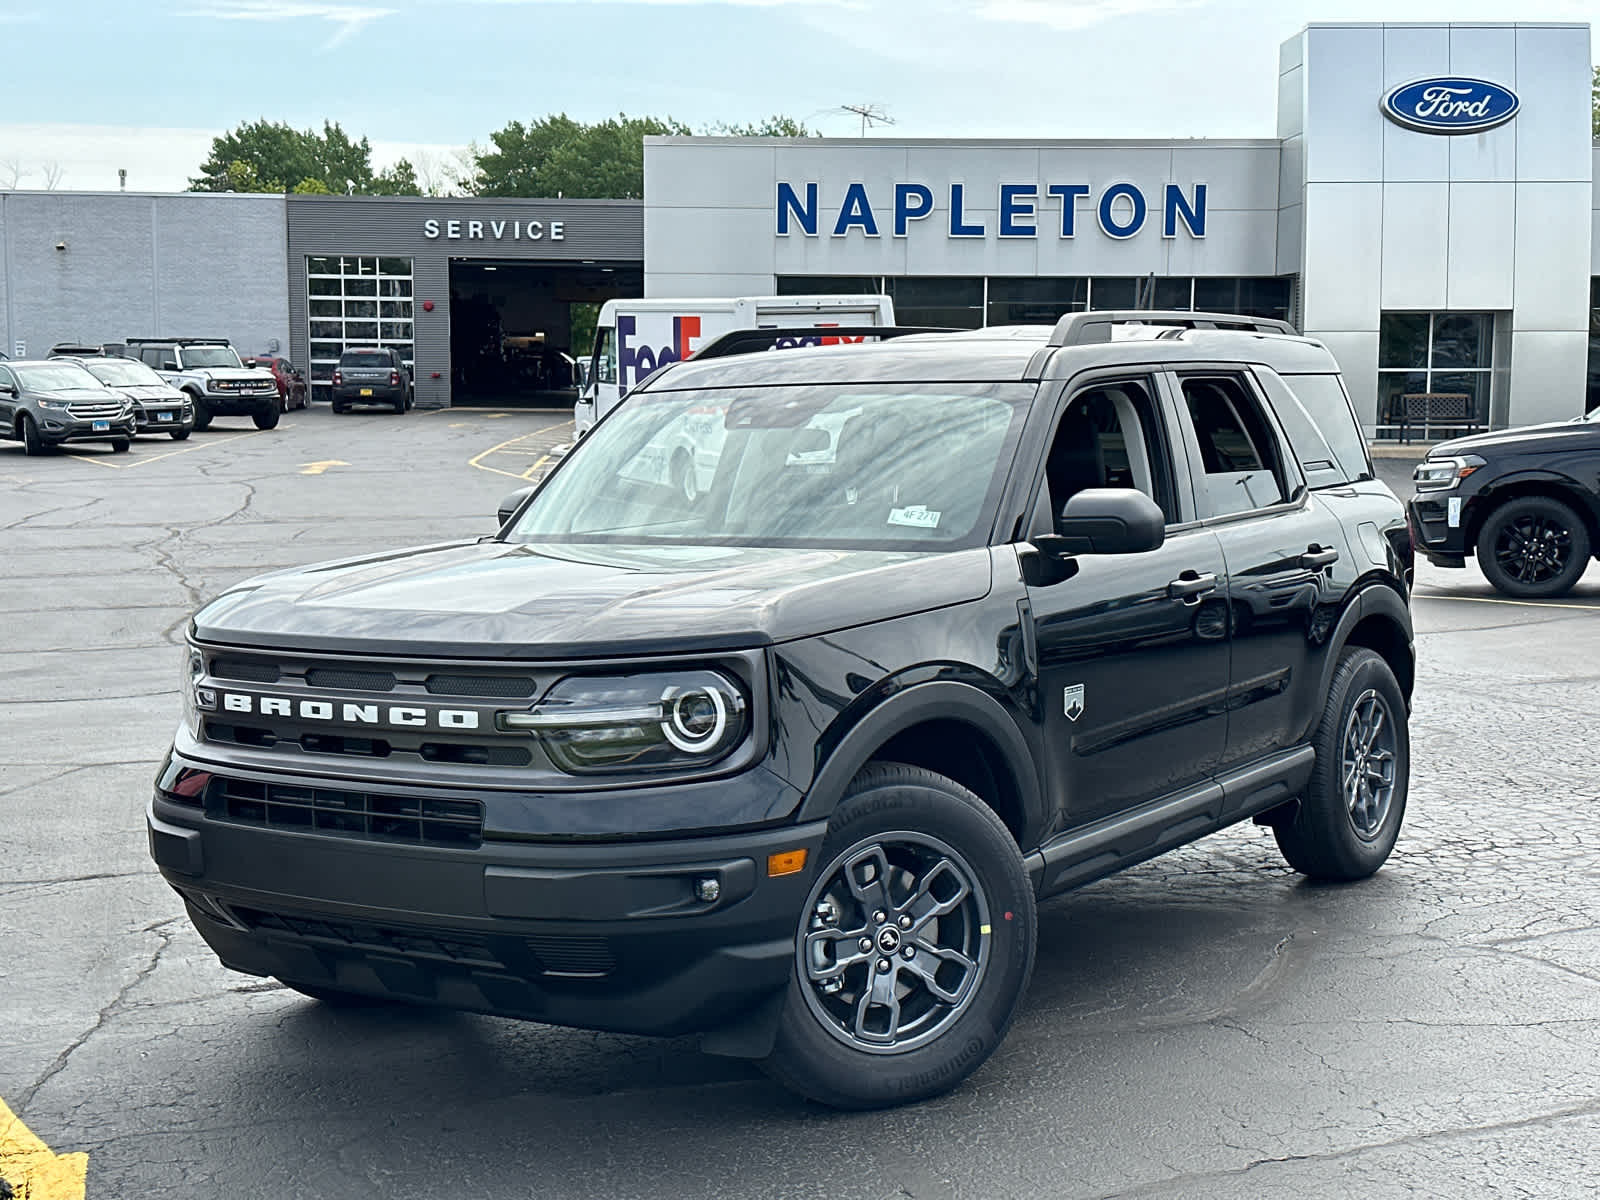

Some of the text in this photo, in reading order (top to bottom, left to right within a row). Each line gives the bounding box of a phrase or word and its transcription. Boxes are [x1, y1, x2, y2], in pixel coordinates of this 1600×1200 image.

[1415, 86, 1492, 117] Ford
[776, 181, 1208, 239] NAPLETON
[424, 219, 565, 240] SERVICE
[224, 693, 479, 729] BRONCO
